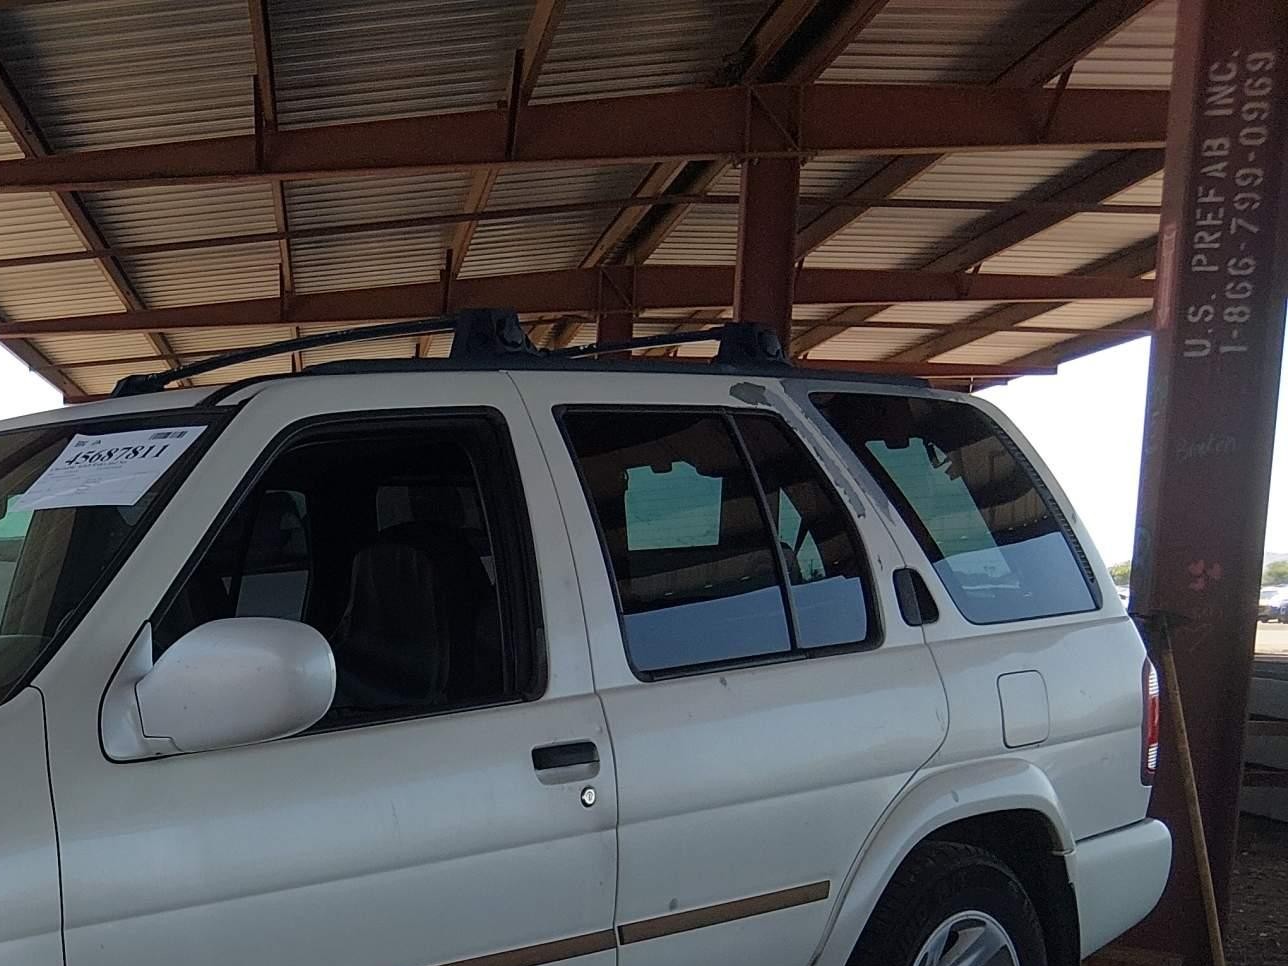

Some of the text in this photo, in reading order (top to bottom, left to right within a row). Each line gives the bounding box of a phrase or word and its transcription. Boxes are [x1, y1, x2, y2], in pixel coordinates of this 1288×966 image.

[1183, 50, 1240, 358] U.S. PREFAB INC.
[1218, 51, 1276, 354] 1-866-799-0969
[64, 442, 171, 466] 45687811
